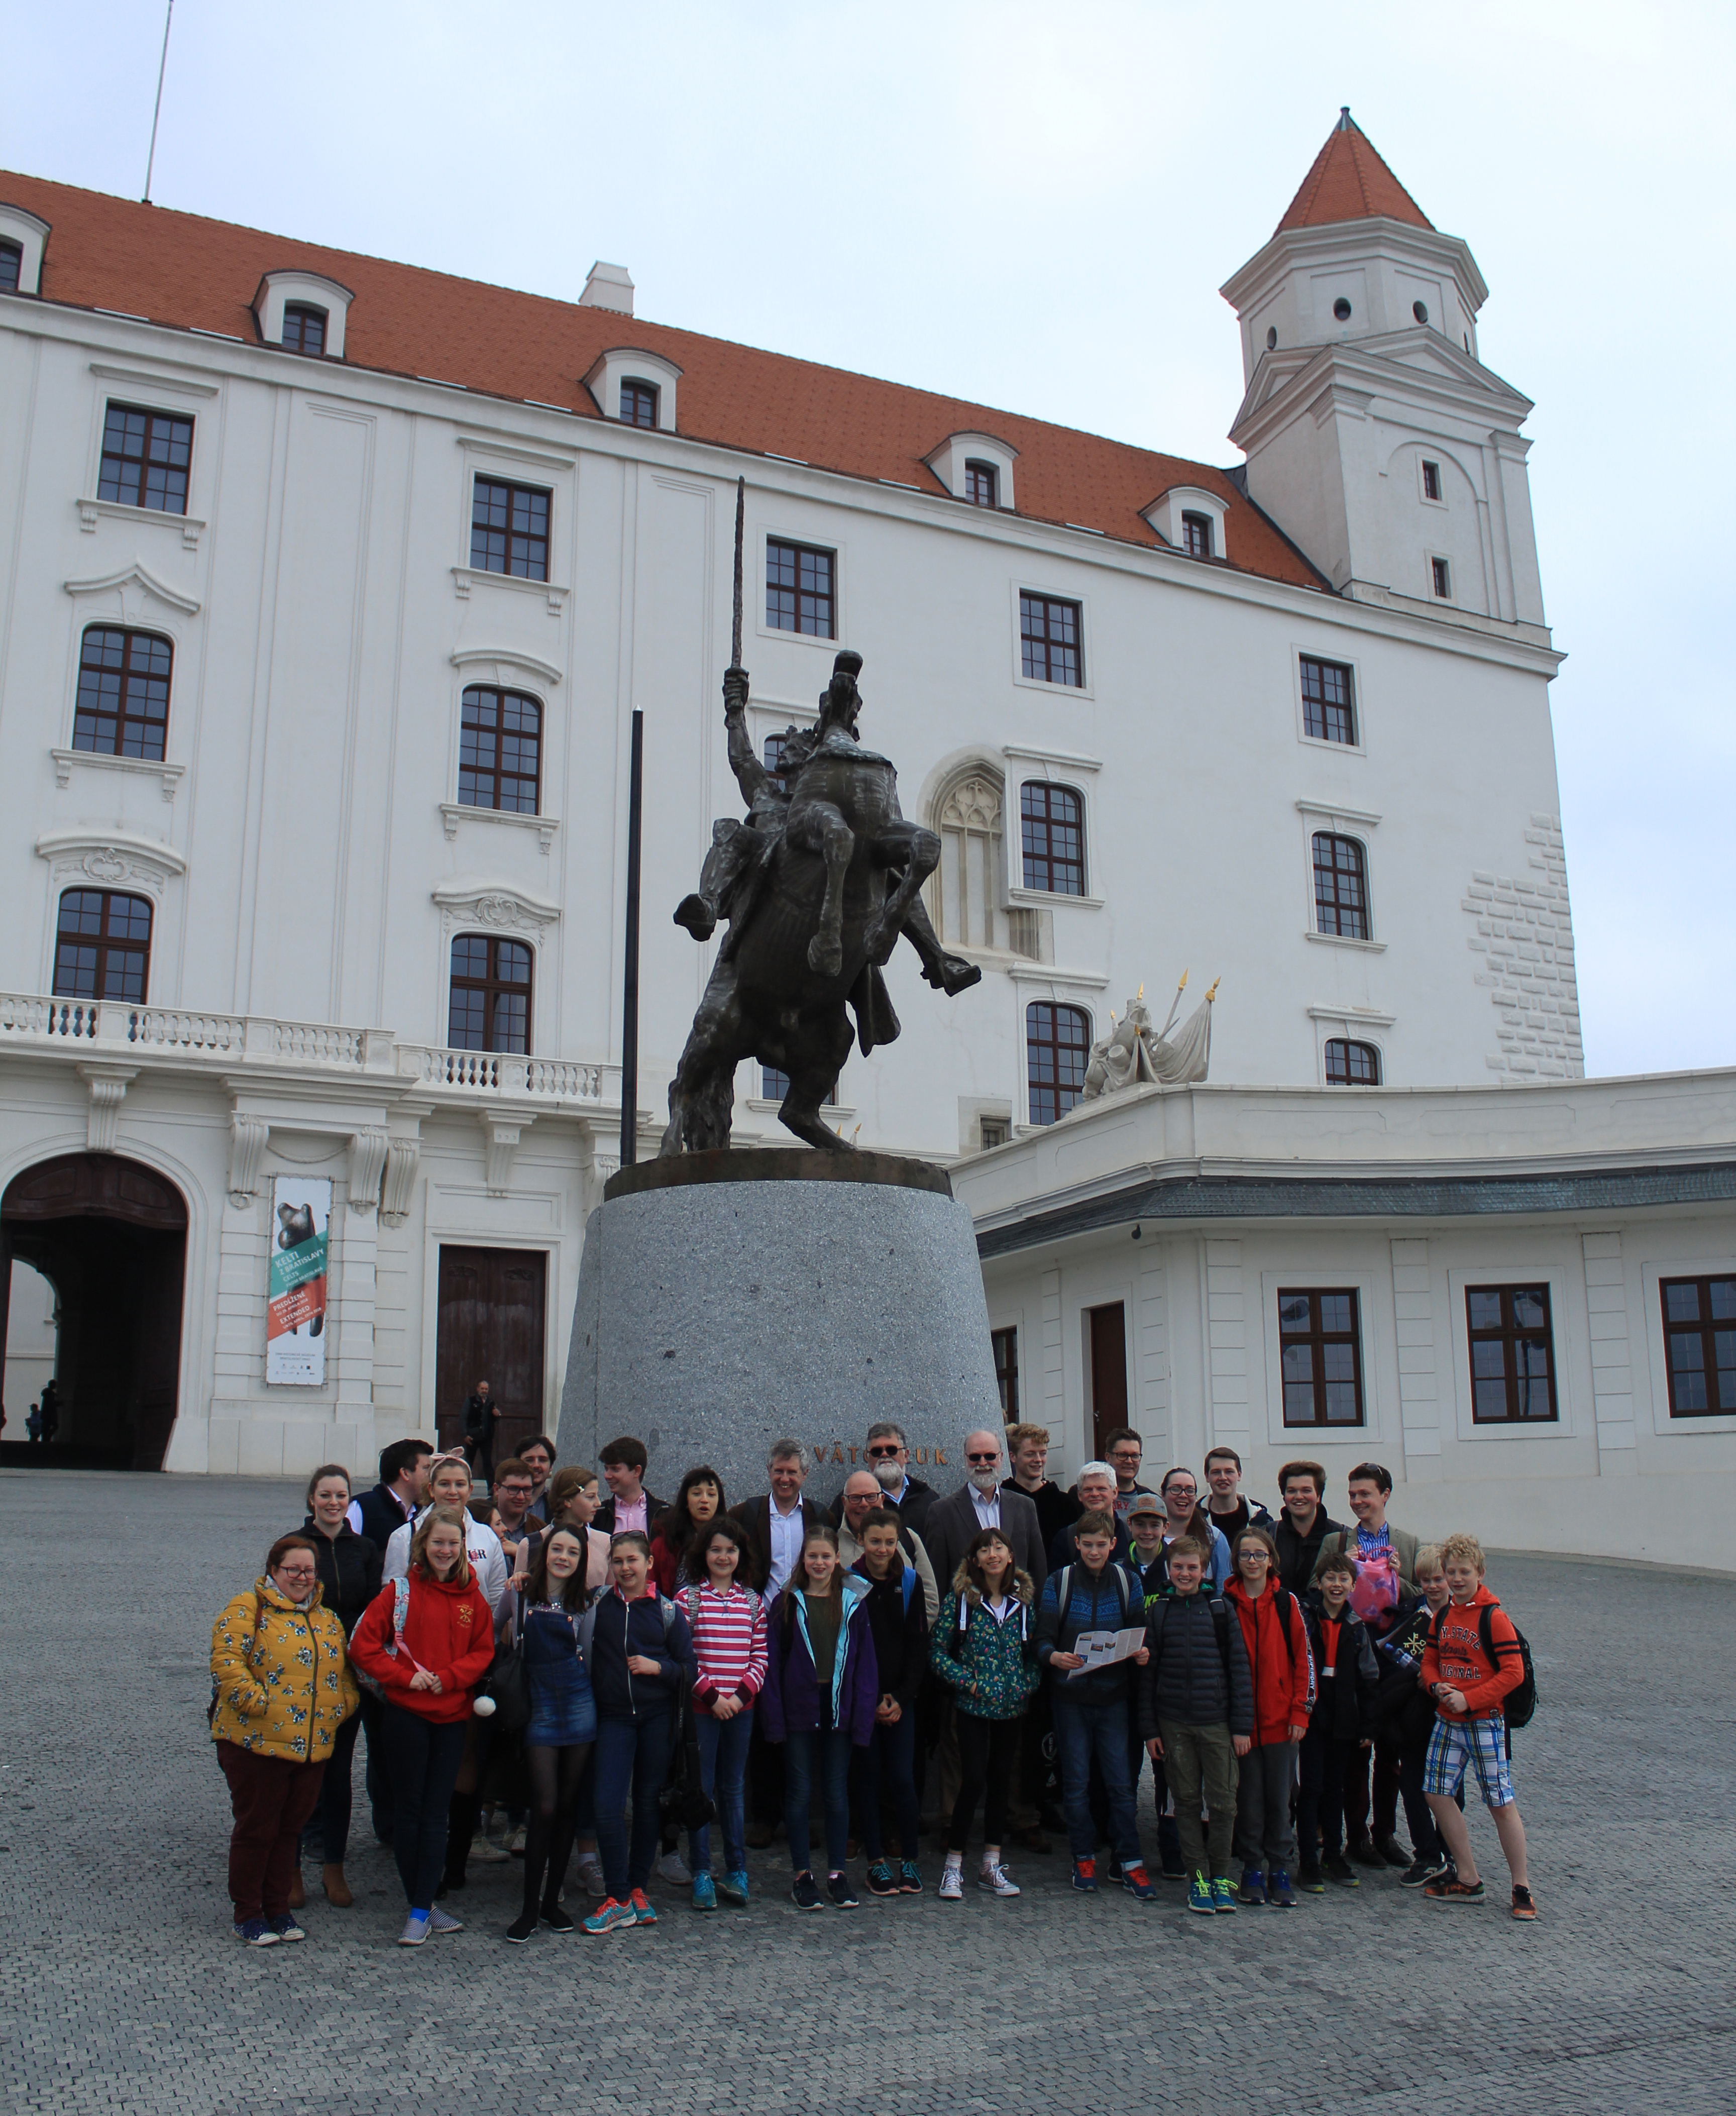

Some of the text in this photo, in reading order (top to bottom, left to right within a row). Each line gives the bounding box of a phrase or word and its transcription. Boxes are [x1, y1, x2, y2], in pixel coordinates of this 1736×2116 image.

[275, 1251, 299, 1268] KELTI
[284, 1248, 324, 1272] BRATISLAVY
[283, 1271, 299, 1282] CELTS
[279, 1305, 310, 1324] EXTENDED
